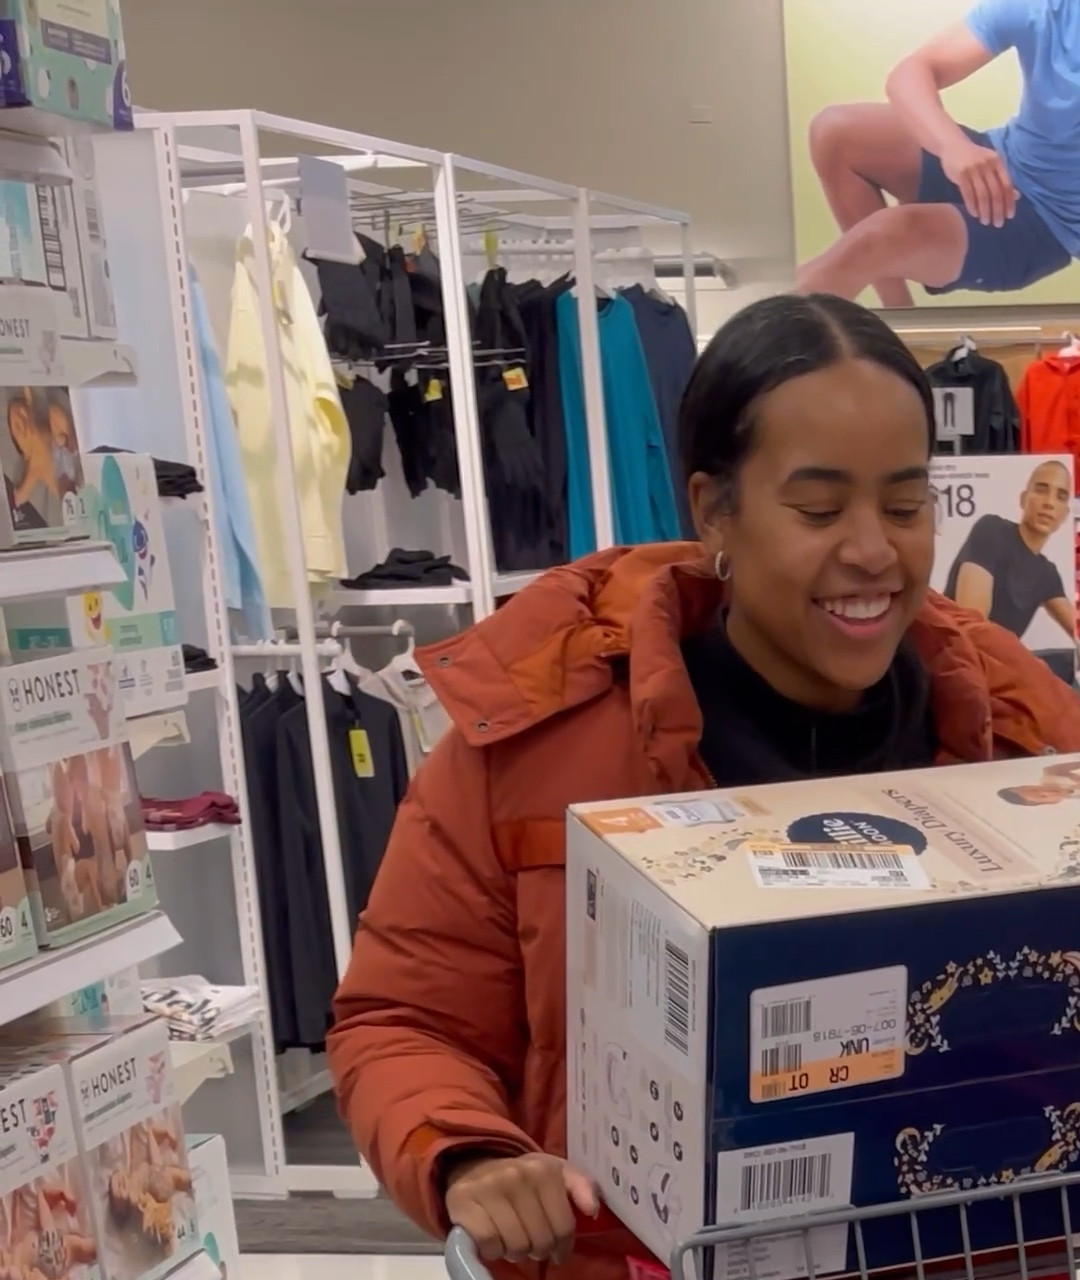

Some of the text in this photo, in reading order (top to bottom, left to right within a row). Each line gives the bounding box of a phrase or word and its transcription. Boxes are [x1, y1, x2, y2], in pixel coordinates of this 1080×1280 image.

[0, 318, 30, 338] ONEST
[937, 484, 976, 518] 18
[22, 668, 81, 706] HONEST
[881, 788, 946, 831] Diapers
[822, 817, 872, 846] illie
[851, 819, 894, 845] OON
[948, 830, 1004, 873] Luxury
[128, 867, 140, 889] 60
[145, 864, 152, 881] 4
[20, 910, 29, 930] 4
[839, 1037, 870, 1059] UNK
[90, 1056, 139, 1099] HONEST
[829, 1065, 849, 1084] CR
[0, 1097, 27, 1134] EST
